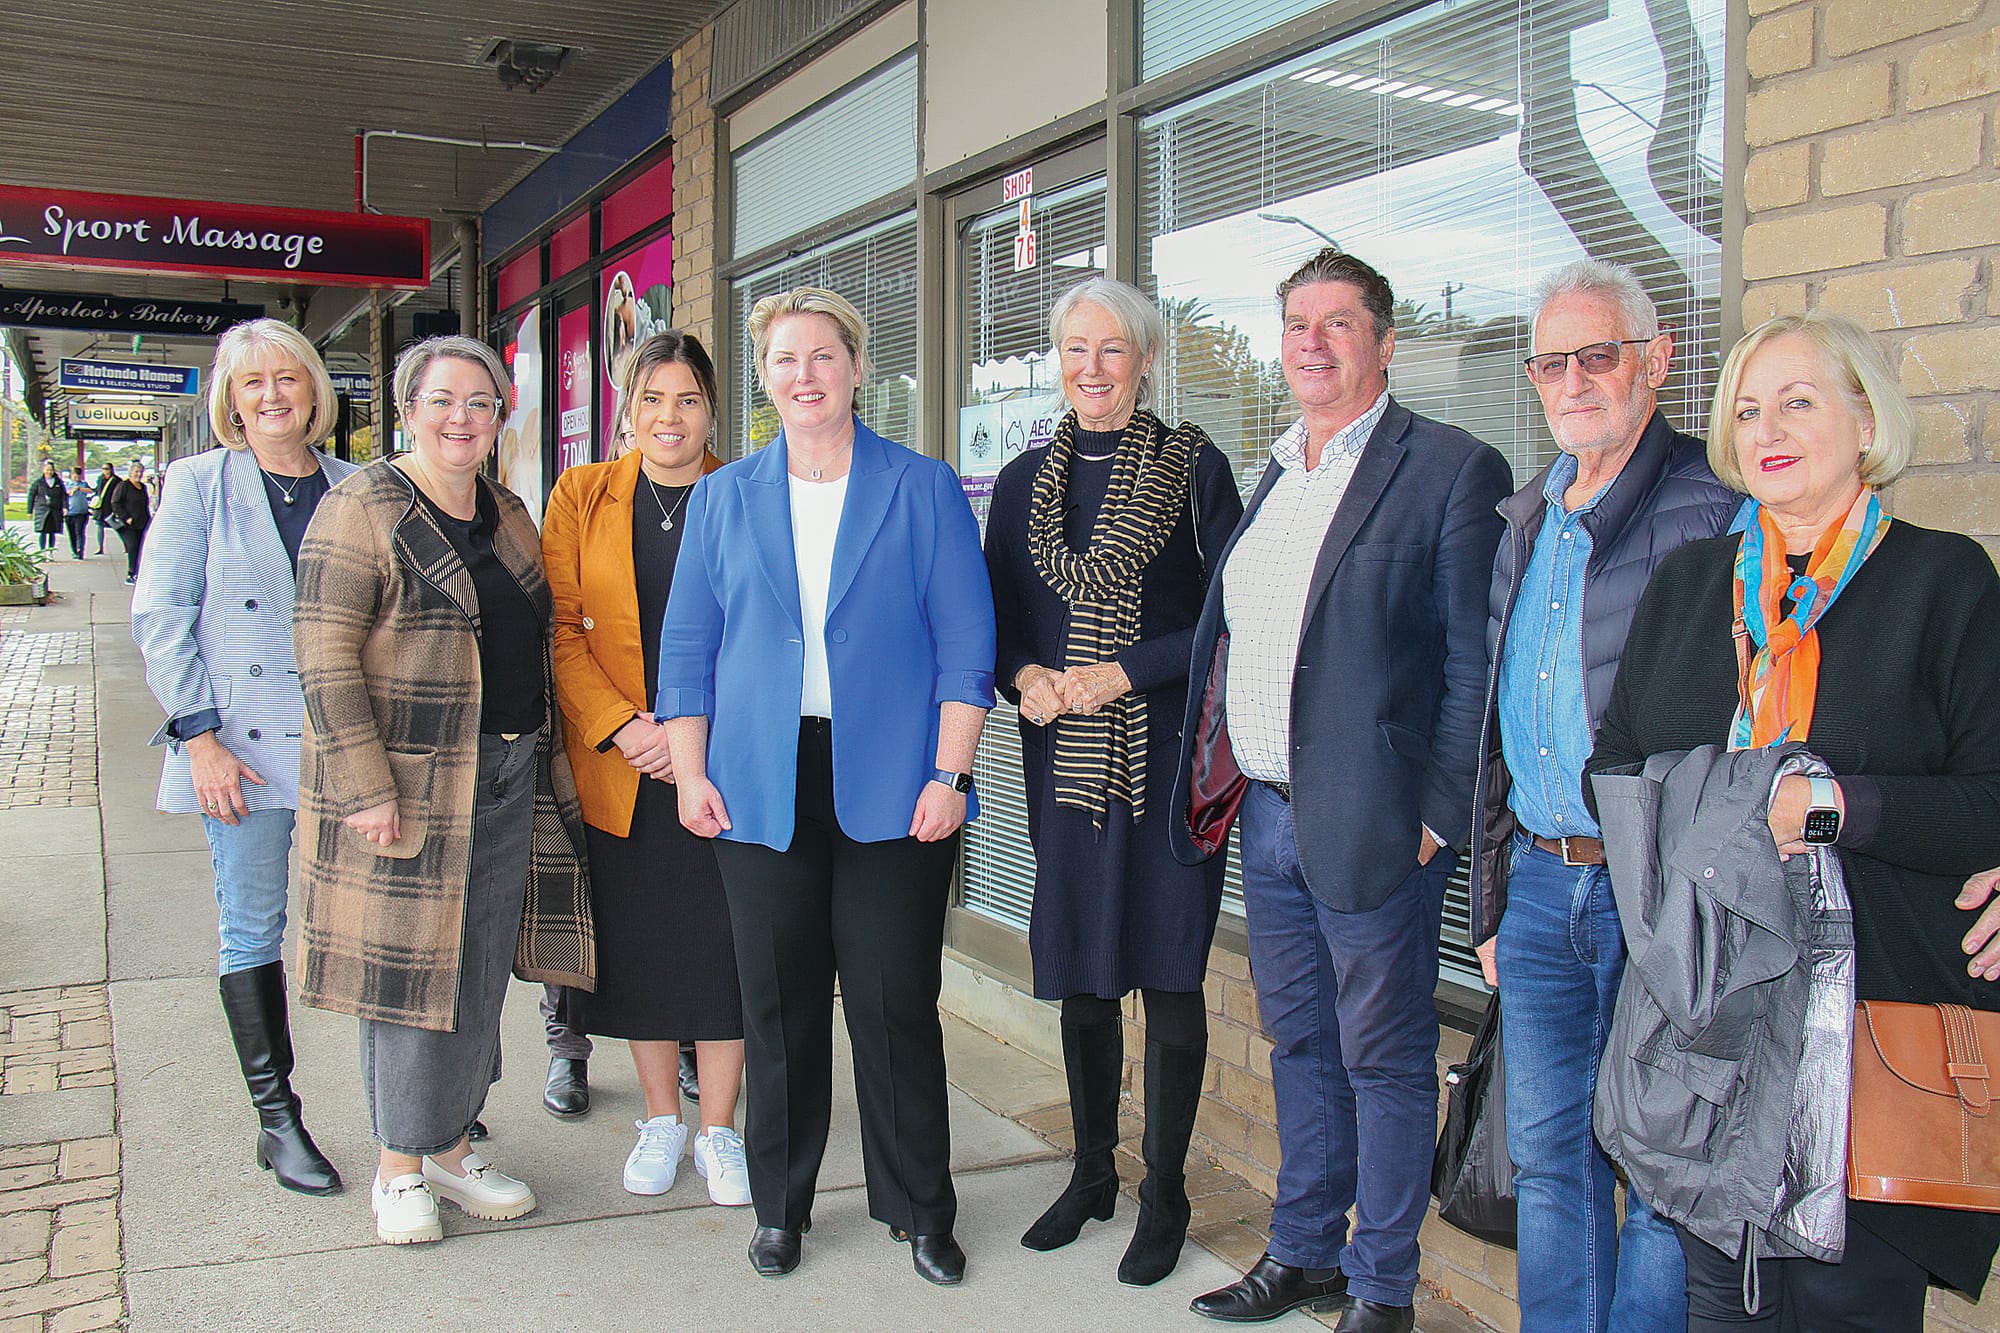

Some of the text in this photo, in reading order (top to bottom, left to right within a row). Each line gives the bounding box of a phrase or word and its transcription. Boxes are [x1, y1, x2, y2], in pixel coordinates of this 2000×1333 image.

[1004, 170, 1031, 200] SHOP
[1021, 201, 1029, 231] 4
[43, 204, 324, 269] Sport Massage
[1017, 233, 1034, 268] 76
[3, 296, 224, 332] Aperloo's Bakery
[83, 365, 184, 383] Hotondo Homes
[106, 380, 146, 389] SELECTIONS
[75, 407, 159, 424] wellways
[1030, 418, 1053, 438] AEC
[563, 443, 569, 470] 7
